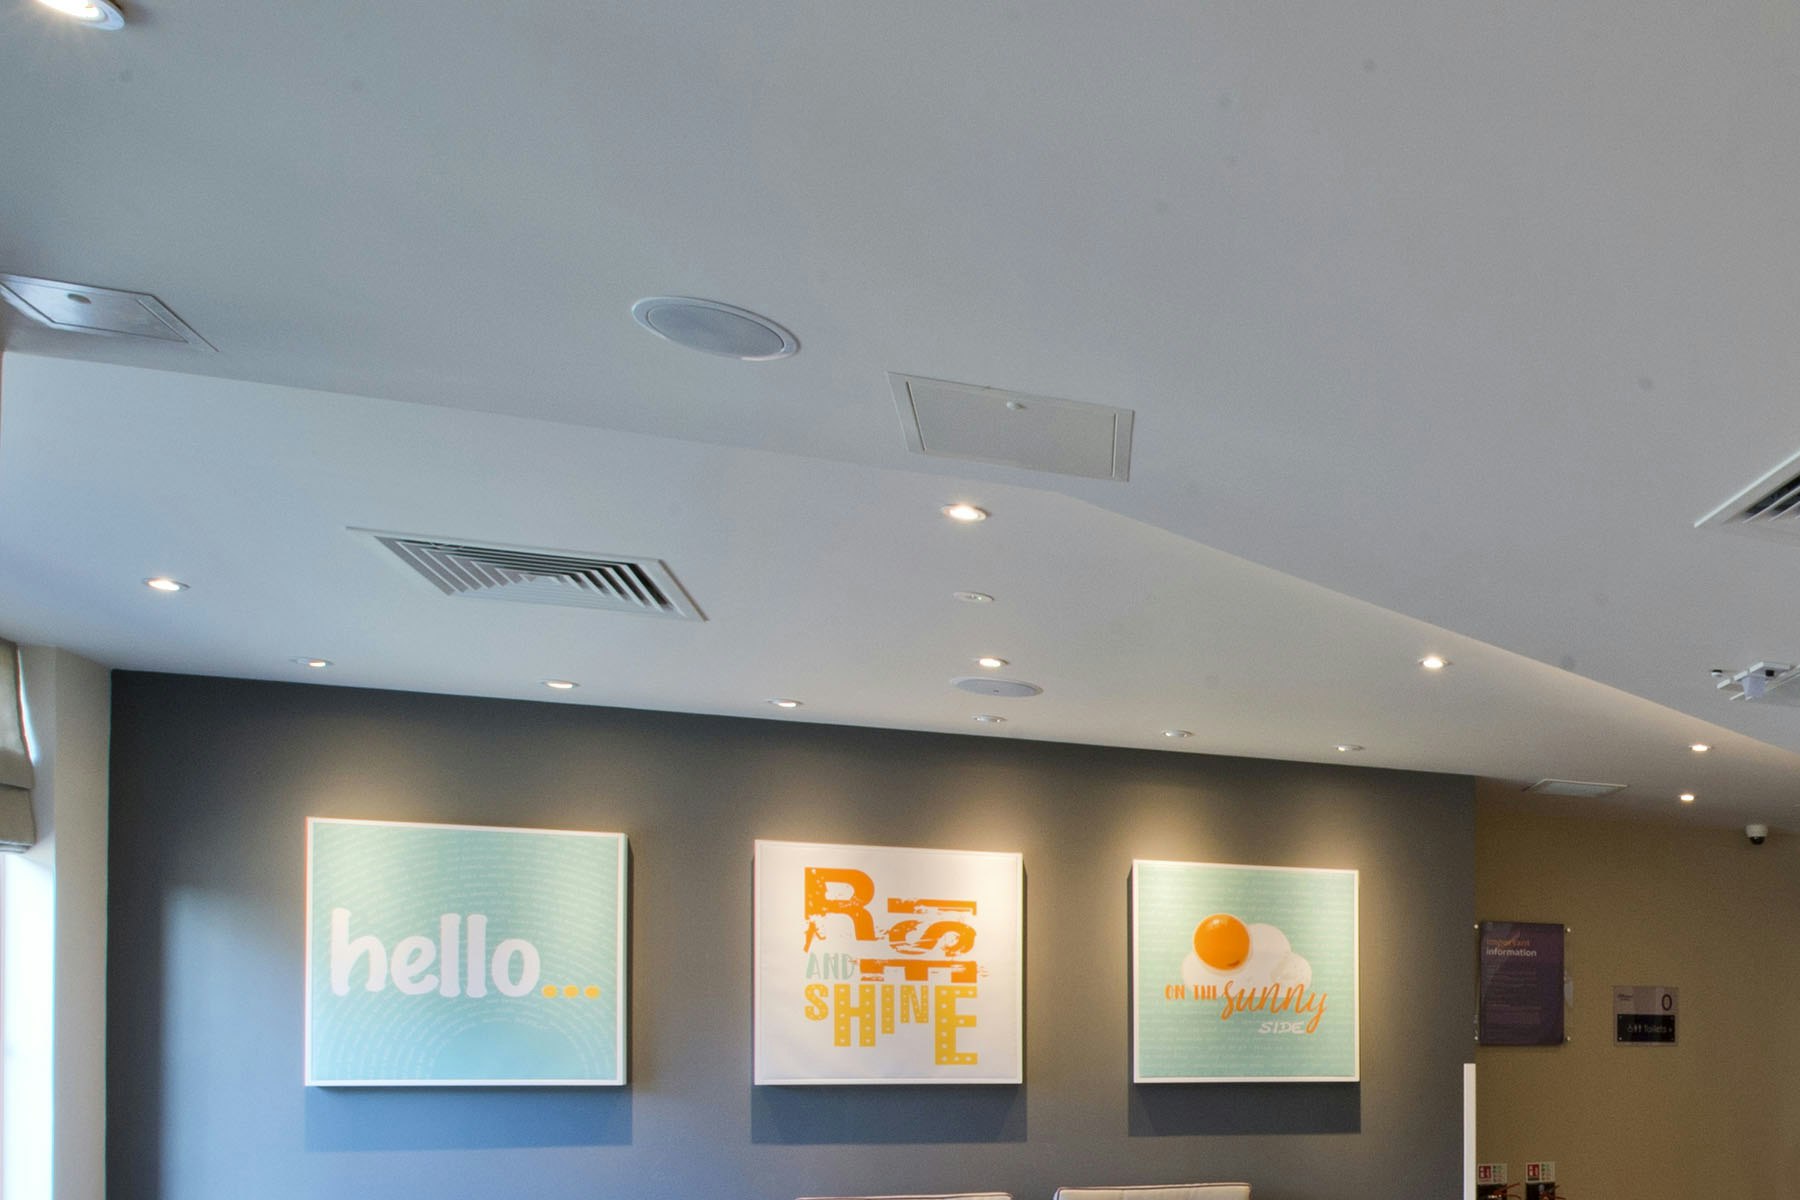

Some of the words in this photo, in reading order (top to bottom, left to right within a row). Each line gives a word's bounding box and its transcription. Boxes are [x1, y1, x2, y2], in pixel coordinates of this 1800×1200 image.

[1486, 947, 1537, 957] information
[806, 953, 855, 980] AND
[1165, 984, 1185, 1000] ON
[804, 983, 978, 1065] SHINE
